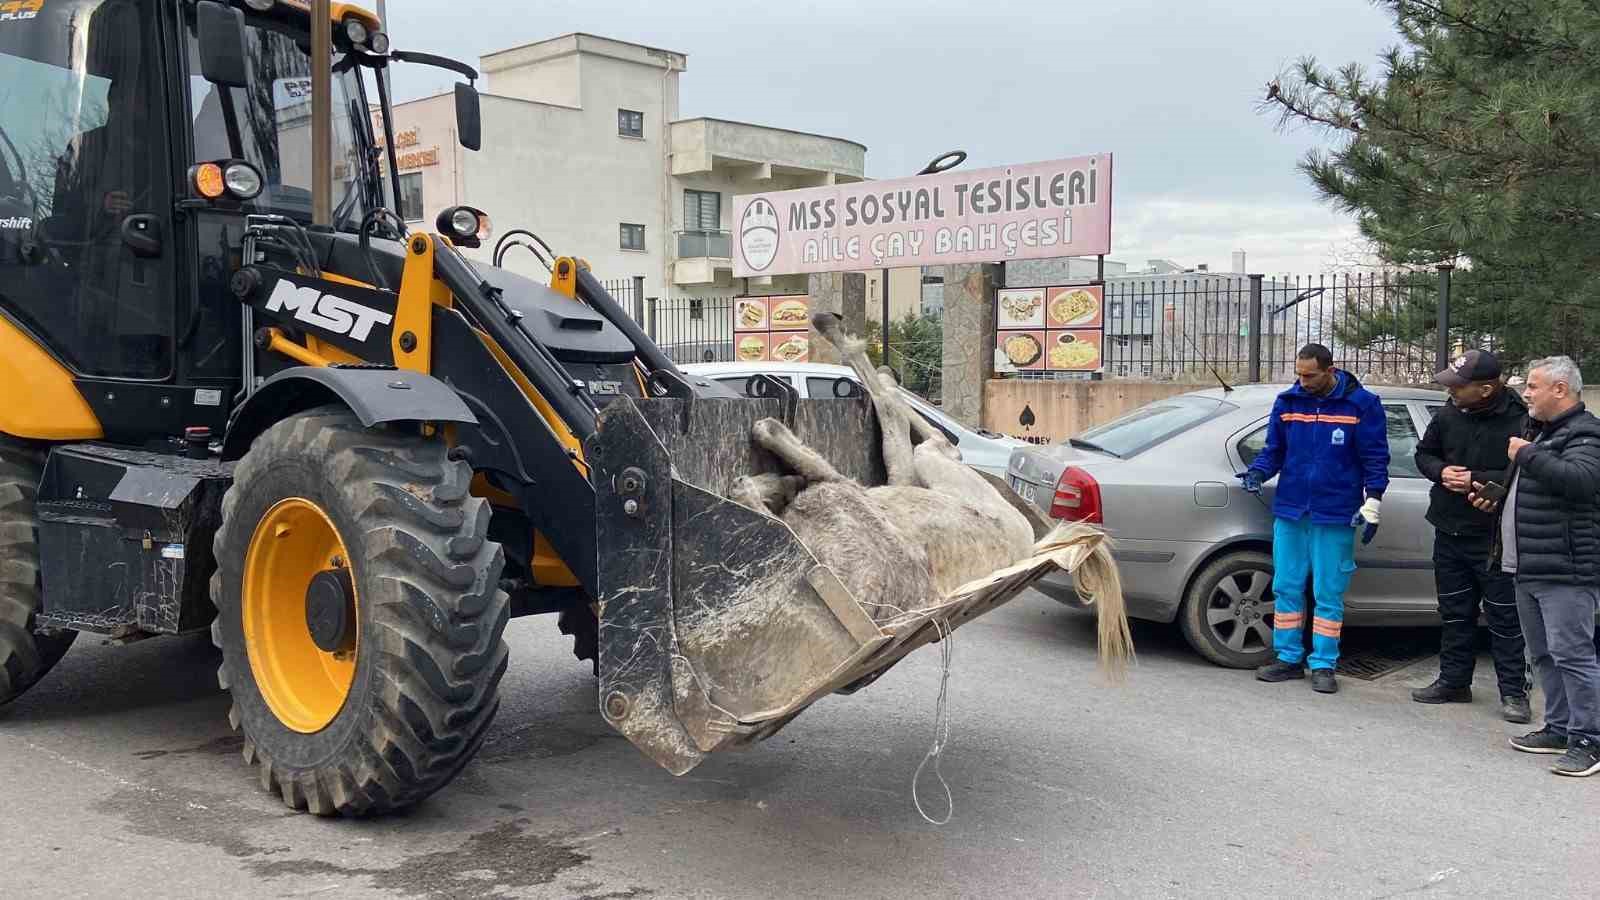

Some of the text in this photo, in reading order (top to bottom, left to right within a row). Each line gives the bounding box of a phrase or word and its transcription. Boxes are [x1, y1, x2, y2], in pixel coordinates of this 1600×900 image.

[788, 157, 1097, 232] MSS SOSYAL TESİSLERİ
[802, 231, 861, 264] AİLE
[870, 229, 925, 265] ÇAY
[935, 208, 1072, 257] BAHÇESİ
[265, 278, 393, 342] MST
[588, 380, 622, 395] MST
